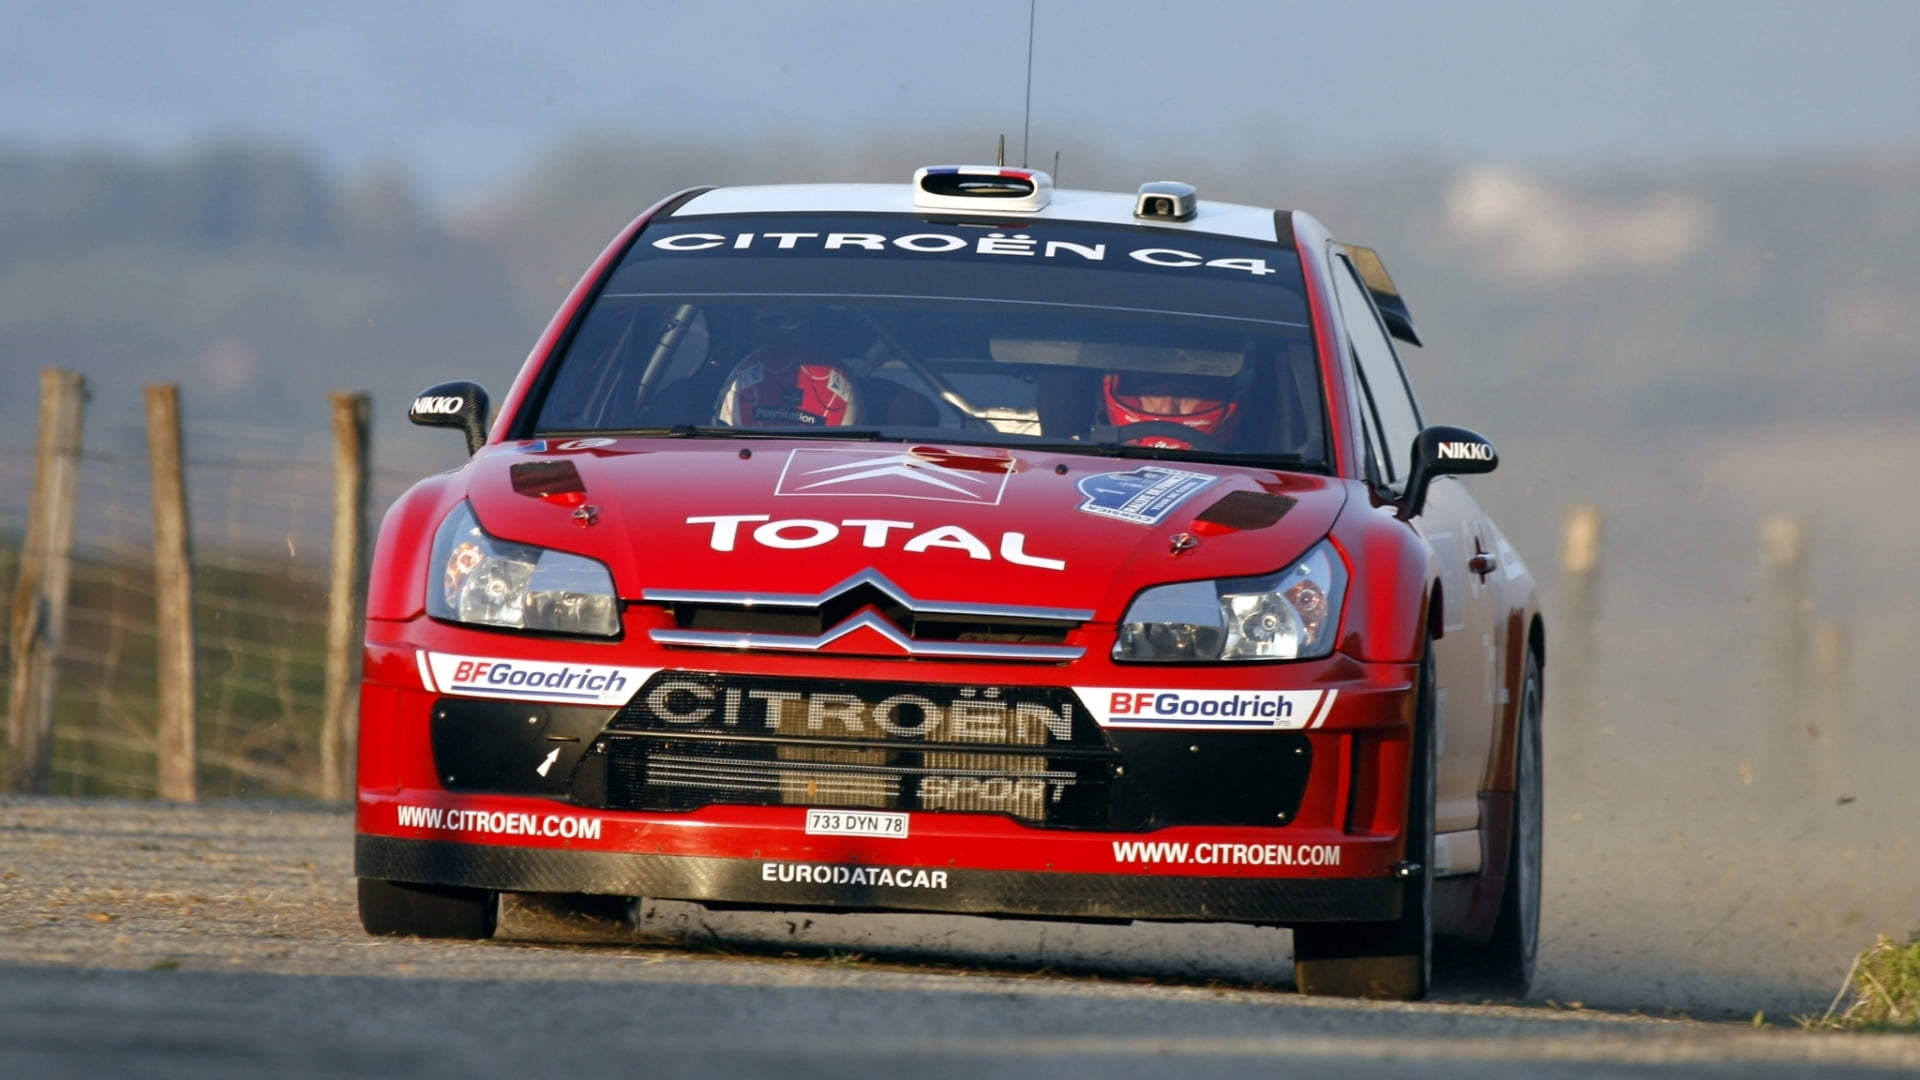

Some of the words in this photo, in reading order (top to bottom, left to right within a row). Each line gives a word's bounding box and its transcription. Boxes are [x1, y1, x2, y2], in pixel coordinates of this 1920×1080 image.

[652, 232, 1106, 261] CITROËN
[1128, 248, 1276, 275] C4
[411, 396, 464, 415] NIKKO
[755, 406, 815, 424] PlayStation
[1437, 441, 1494, 461] NIKKO
[686, 514, 1066, 571] TOTAL
[453, 661, 627, 692] BFGoodrich
[645, 680, 1073, 741] CITROËN
[1109, 692, 1293, 717] BFGoodrich
[916, 775, 1077, 802] SPORT
[397, 805, 601, 840] WWW.CITROEN.COM
[812, 814, 841, 831] 733
[845, 816, 879, 833] DYN
[884, 818, 903, 834] 78
[1112, 841, 1341, 866] WWW.CITROEN.COM
[762, 863, 948, 889] EURODATACAR
